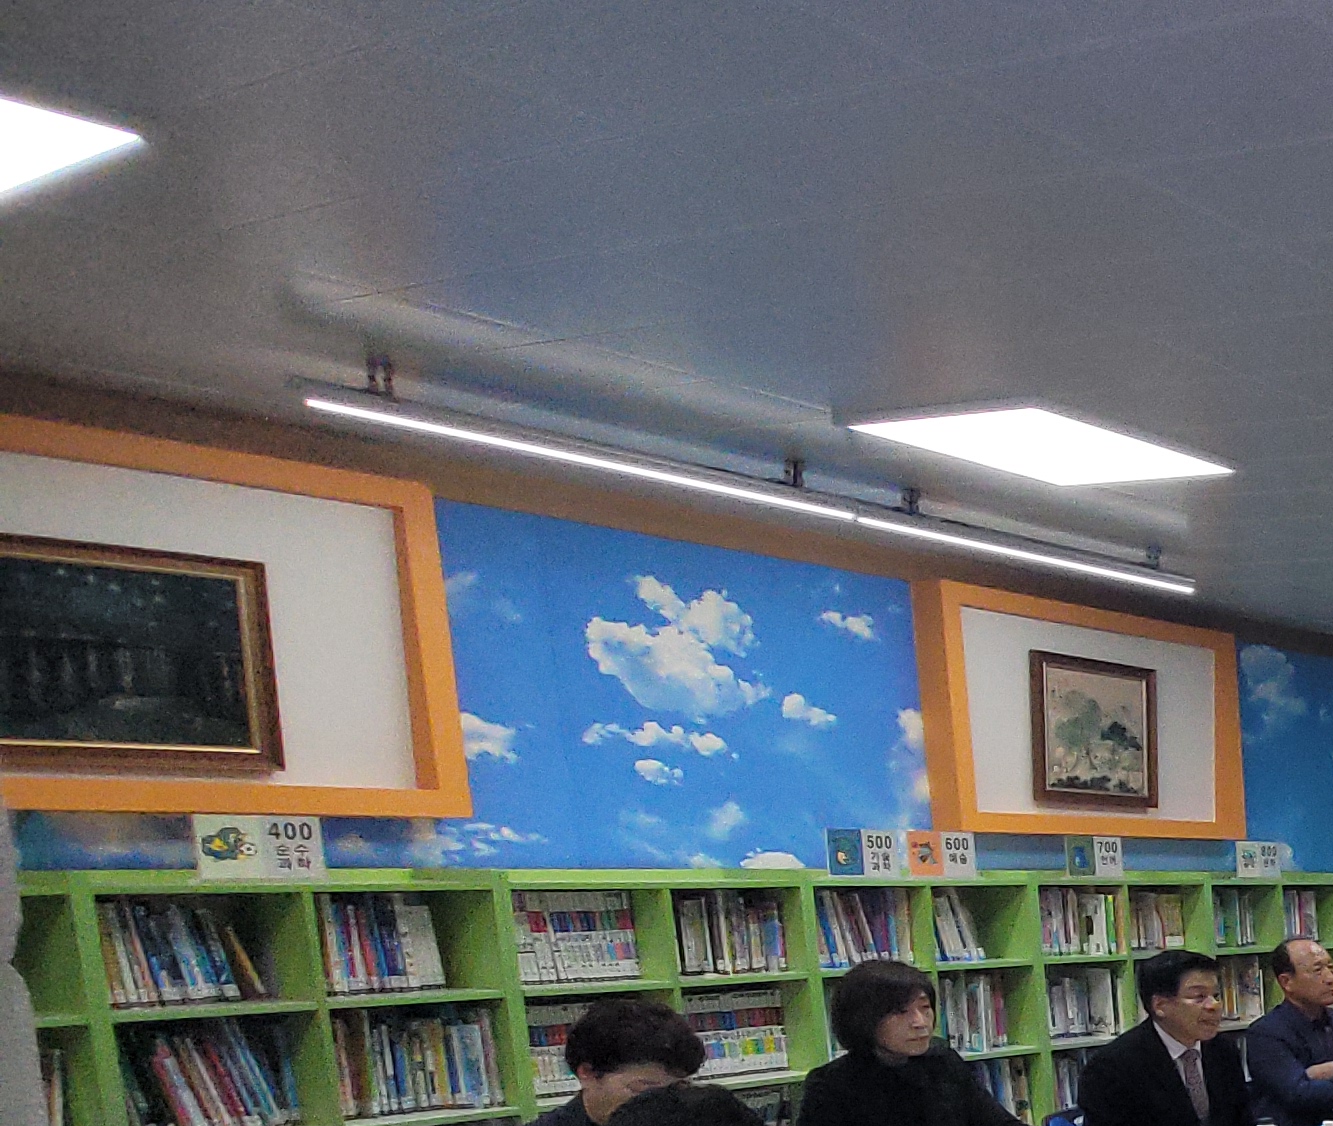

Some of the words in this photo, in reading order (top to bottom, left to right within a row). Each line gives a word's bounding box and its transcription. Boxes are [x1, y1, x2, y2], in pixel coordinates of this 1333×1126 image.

[267, 822, 312, 840] 400
[866, 834, 892, 849] 500
[945, 837, 969, 850] 600
[1096, 841, 1118, 853] 700
